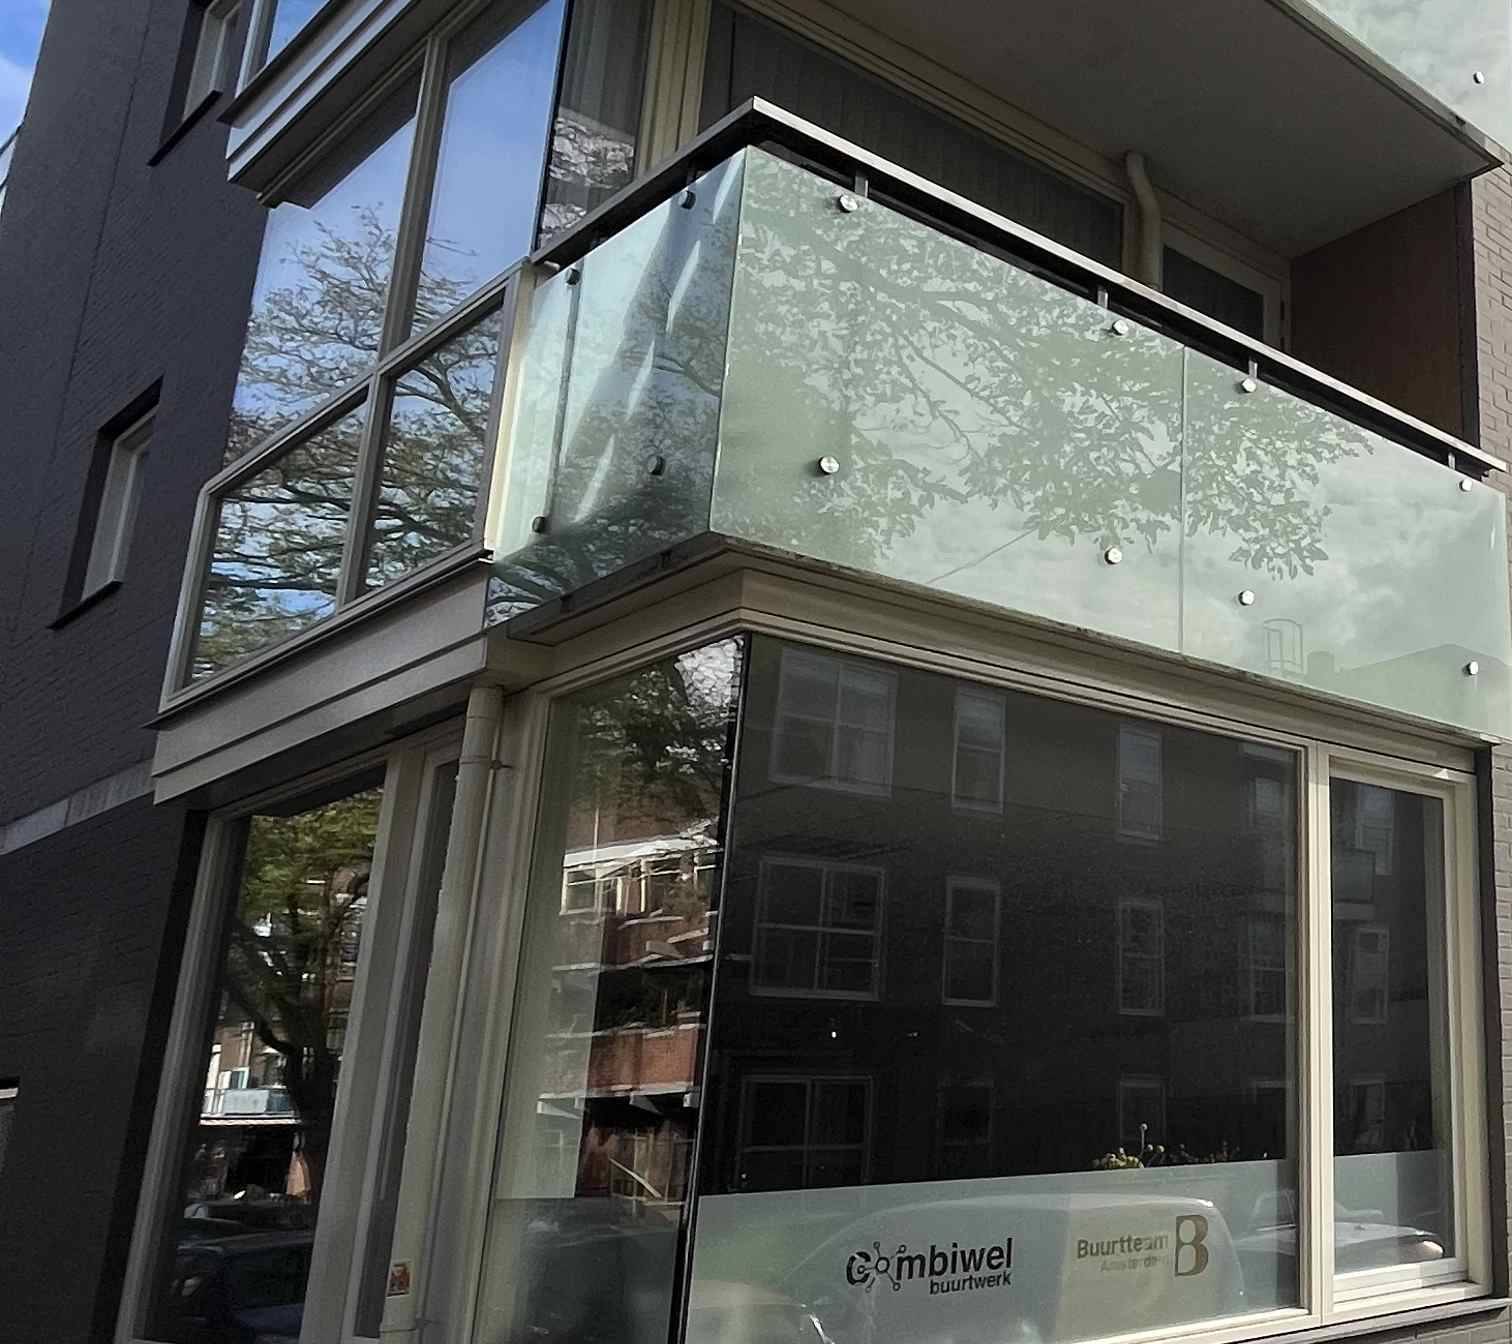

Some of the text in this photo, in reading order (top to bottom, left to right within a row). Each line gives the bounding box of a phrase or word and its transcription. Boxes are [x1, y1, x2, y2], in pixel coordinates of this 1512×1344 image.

[1076, 1234, 1169, 1259] Buurtteam
[846, 1237, 1013, 1290] Combiwel
[929, 1270, 1012, 1295] buurtwerk
